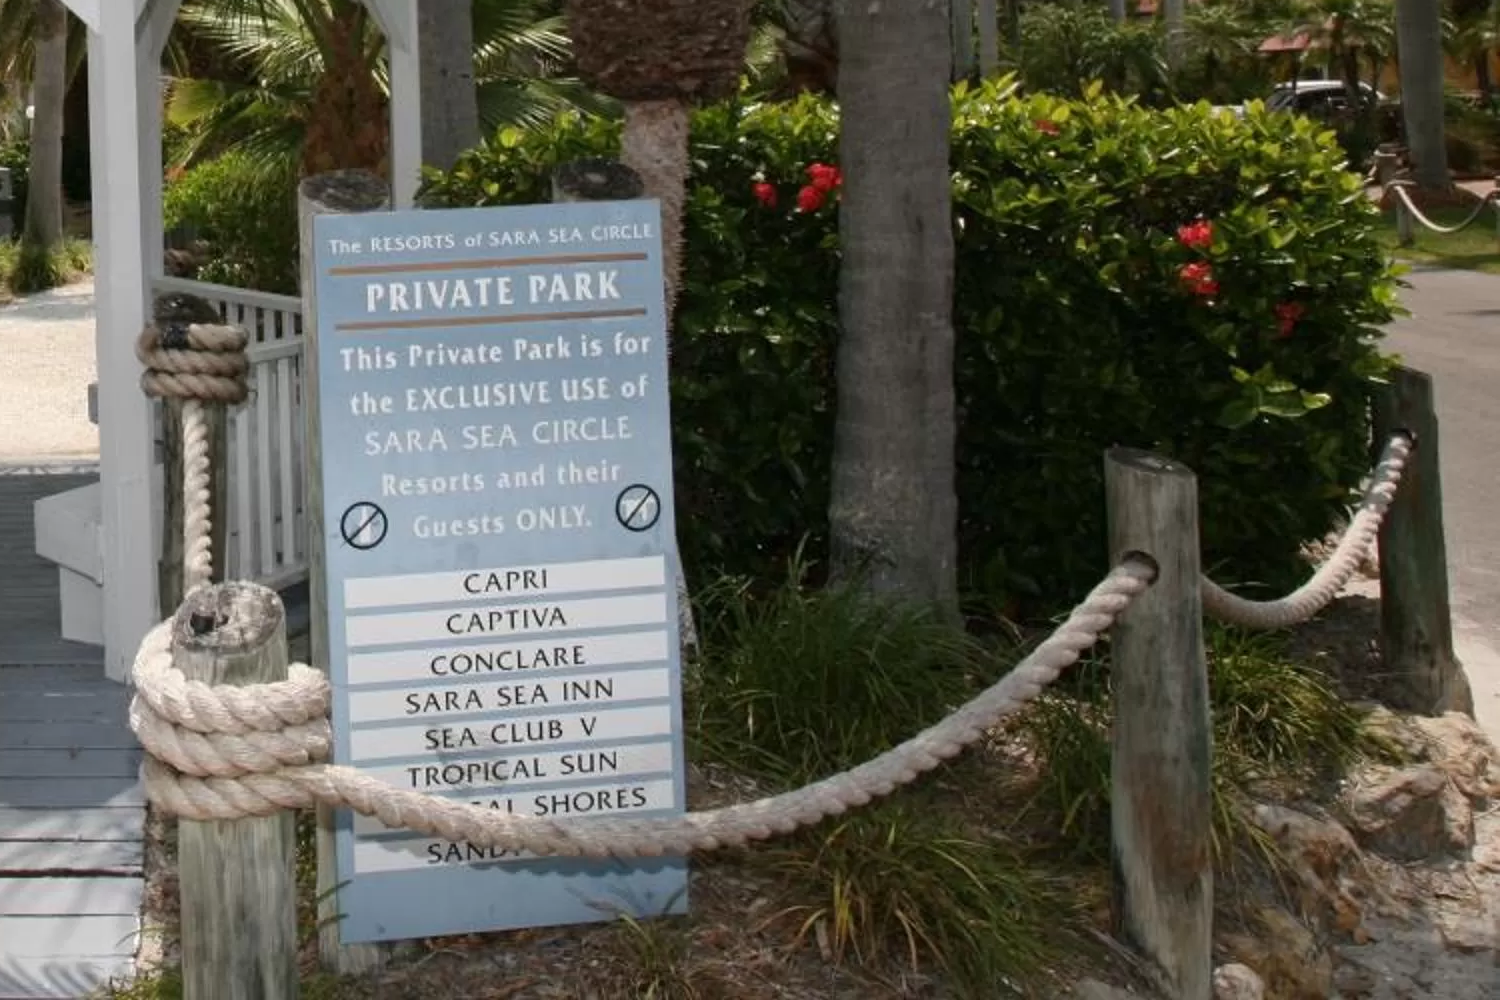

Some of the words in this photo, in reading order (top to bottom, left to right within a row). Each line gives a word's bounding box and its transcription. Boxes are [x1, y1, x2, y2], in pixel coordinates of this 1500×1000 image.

[329, 238, 360, 255] The
[370, 234, 454, 252] RESORTS
[465, 233, 482, 248] of
[489, 229, 539, 247] SARA
[548, 226, 582, 244] SEA
[591, 224, 652, 242] CIRCLE
[366, 276, 514, 312] PRIVATE
[528, 270, 620, 303] PARK
[340, 346, 397, 372] This
[409, 341, 501, 367] Private
[514, 336, 570, 362] Park
[580, 335, 602, 356] is
[613, 332, 651, 355] for
[350, 392, 392, 416] the
[406, 382, 549, 412] EXCLUSIVE
[562, 378, 610, 402] USE
[620, 375, 648, 399] of
[364, 430, 447, 457] SARA
[462, 423, 517, 450] SEA
[532, 415, 631, 445] CIRCLE
[381, 472, 484, 497] Resorts
[497, 463, 544, 488] and
[557, 461, 620, 485] their
[412, 515, 504, 539] Guests
[517, 508, 592, 531] ONLY.
[463, 569, 548, 594] CAPRI
[446, 607, 566, 634] CAPTIVA
[431, 645, 585, 676] CONCLARE
[405, 689, 482, 714] SARA
[497, 684, 548, 706] SEA
[563, 678, 613, 702] INN
[425, 728, 477, 750] SEA
[490, 720, 562, 744] CLUB
[580, 717, 596, 737] V
[407, 759, 546, 788] TROPICAL
[560, 751, 617, 773] SUN
[534, 787, 646, 816] SHORES
